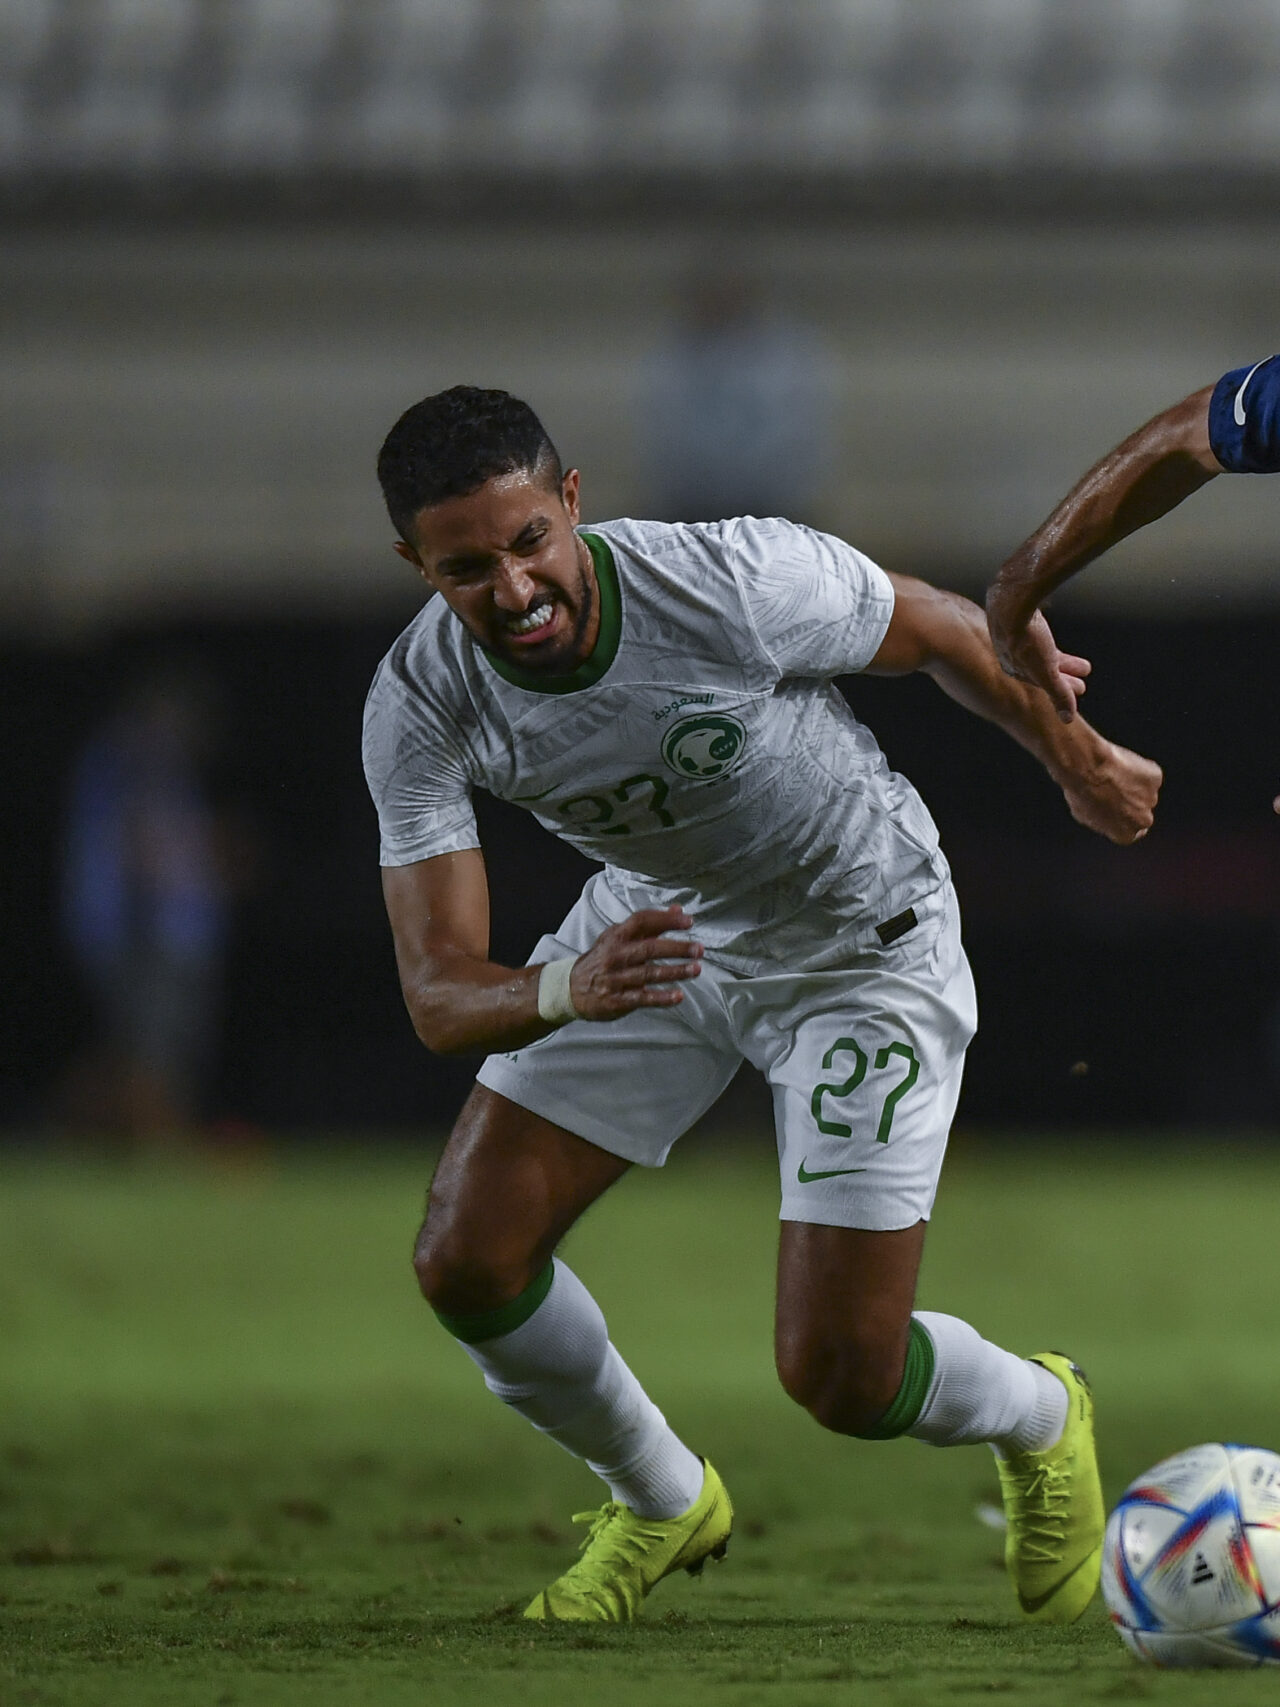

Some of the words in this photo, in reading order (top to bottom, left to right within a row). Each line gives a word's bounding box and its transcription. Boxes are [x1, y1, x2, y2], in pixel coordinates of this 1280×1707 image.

[652, 692, 715, 721] السعودية
[556, 773, 676, 835] 27
[811, 1037, 920, 1144] 27
